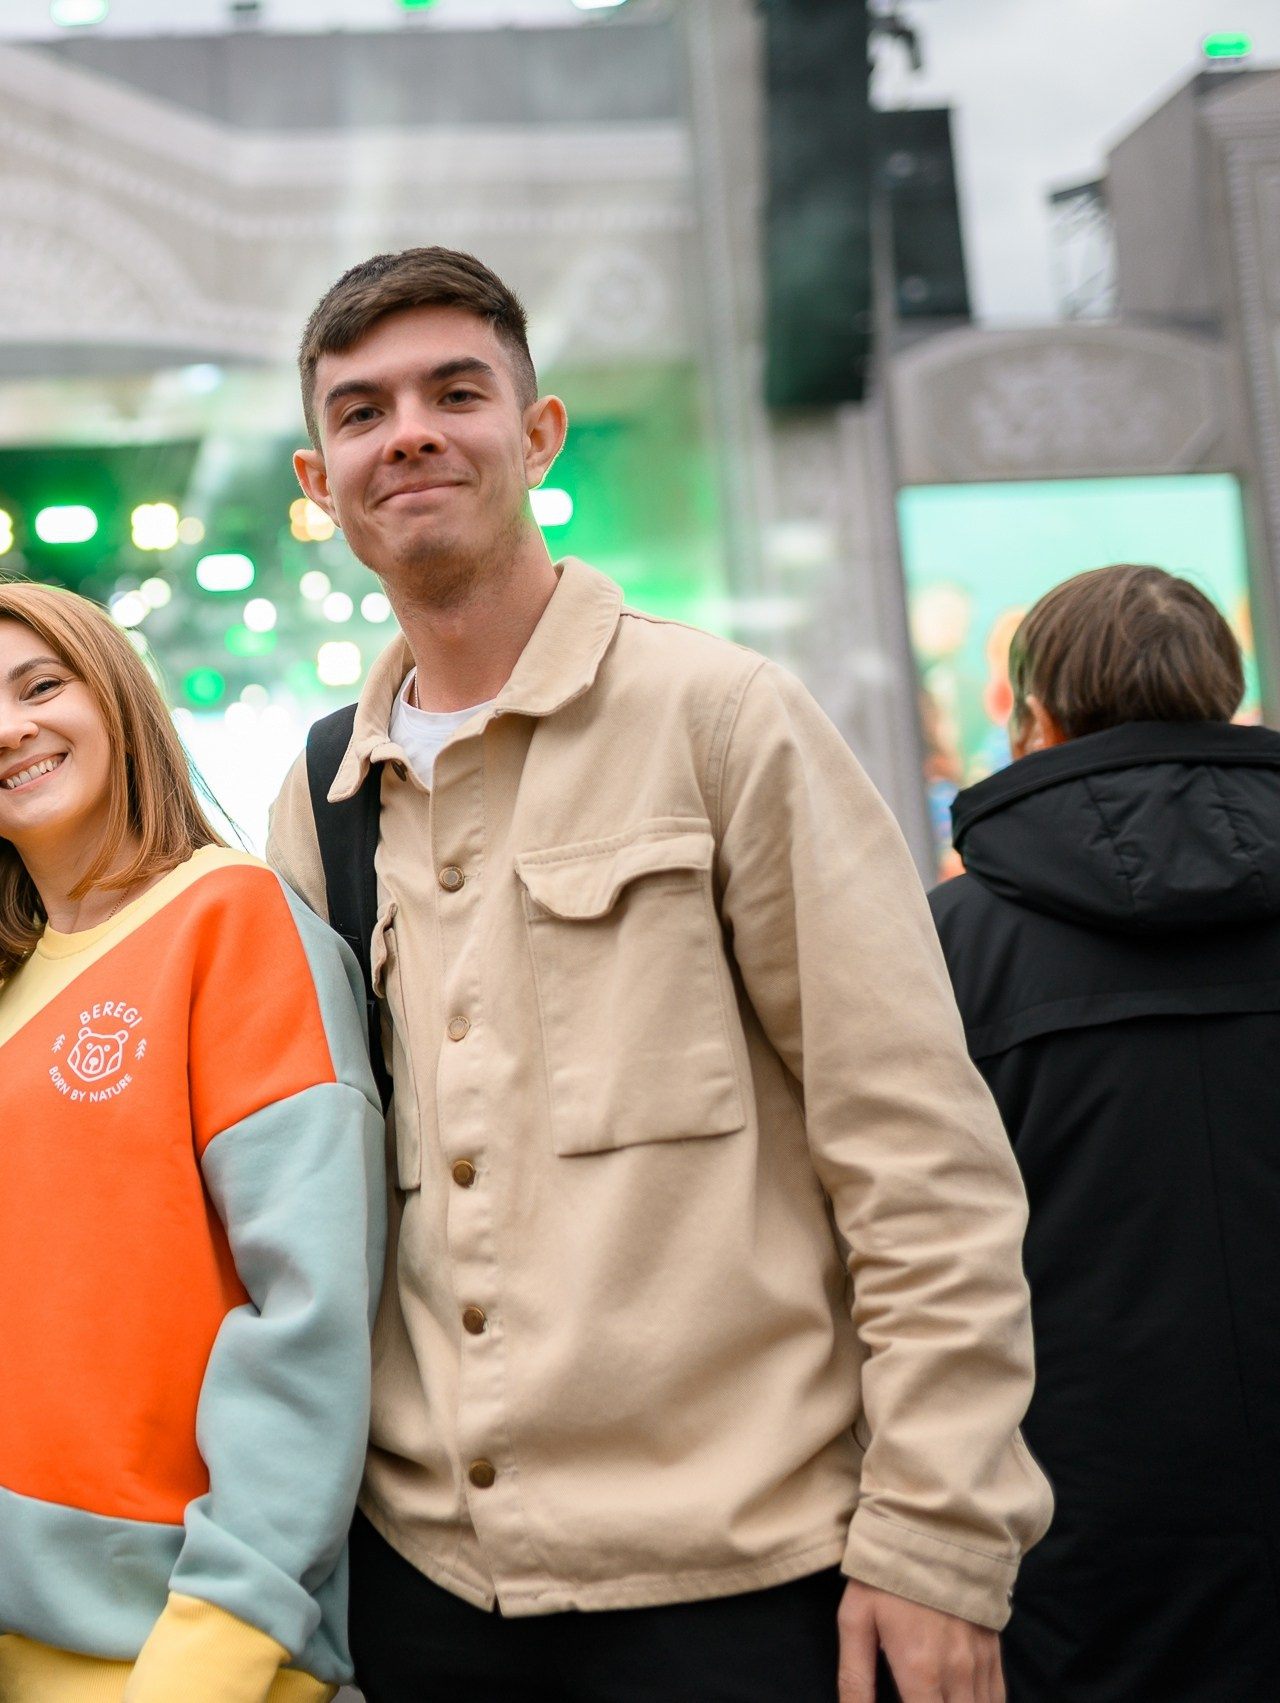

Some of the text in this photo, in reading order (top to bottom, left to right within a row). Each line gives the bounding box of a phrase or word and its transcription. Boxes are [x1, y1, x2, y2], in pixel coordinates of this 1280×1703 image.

[79, 1001, 142, 1028] BEREGI
[48, 1066, 133, 1103] BORN BY NATURE
